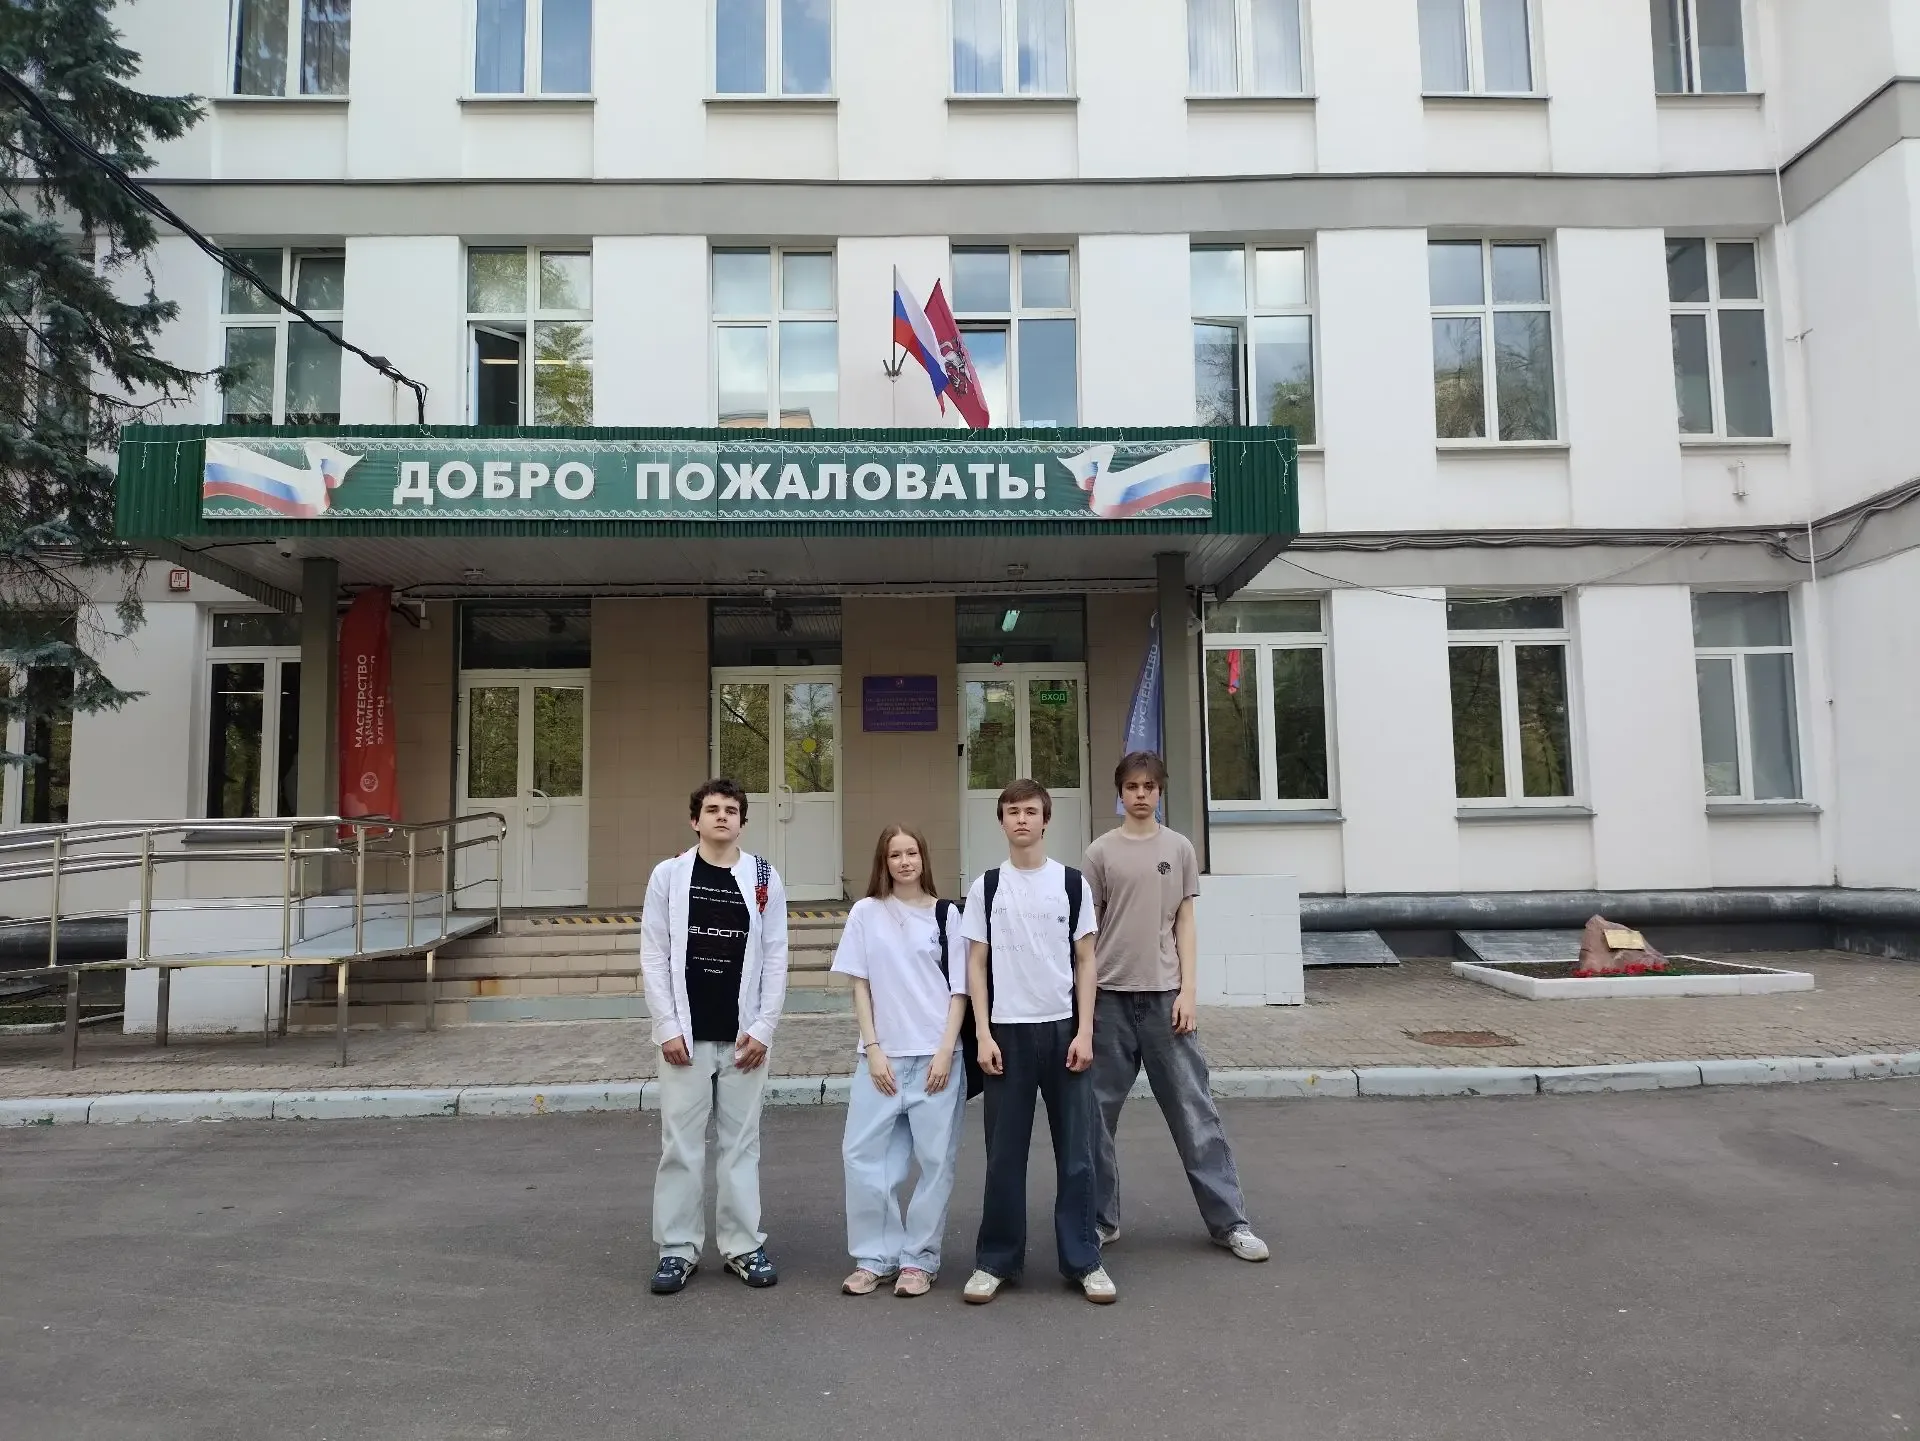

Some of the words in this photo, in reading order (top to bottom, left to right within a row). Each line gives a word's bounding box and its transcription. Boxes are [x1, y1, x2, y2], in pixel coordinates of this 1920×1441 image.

[393, 461, 595, 505] ДОБРО
[636, 462, 1046, 501] ПОЖАЛОВАТЬ!
[355, 654, 367, 748] МАСТЕРСТВО
[1041, 693, 1066, 702] ВХОД
